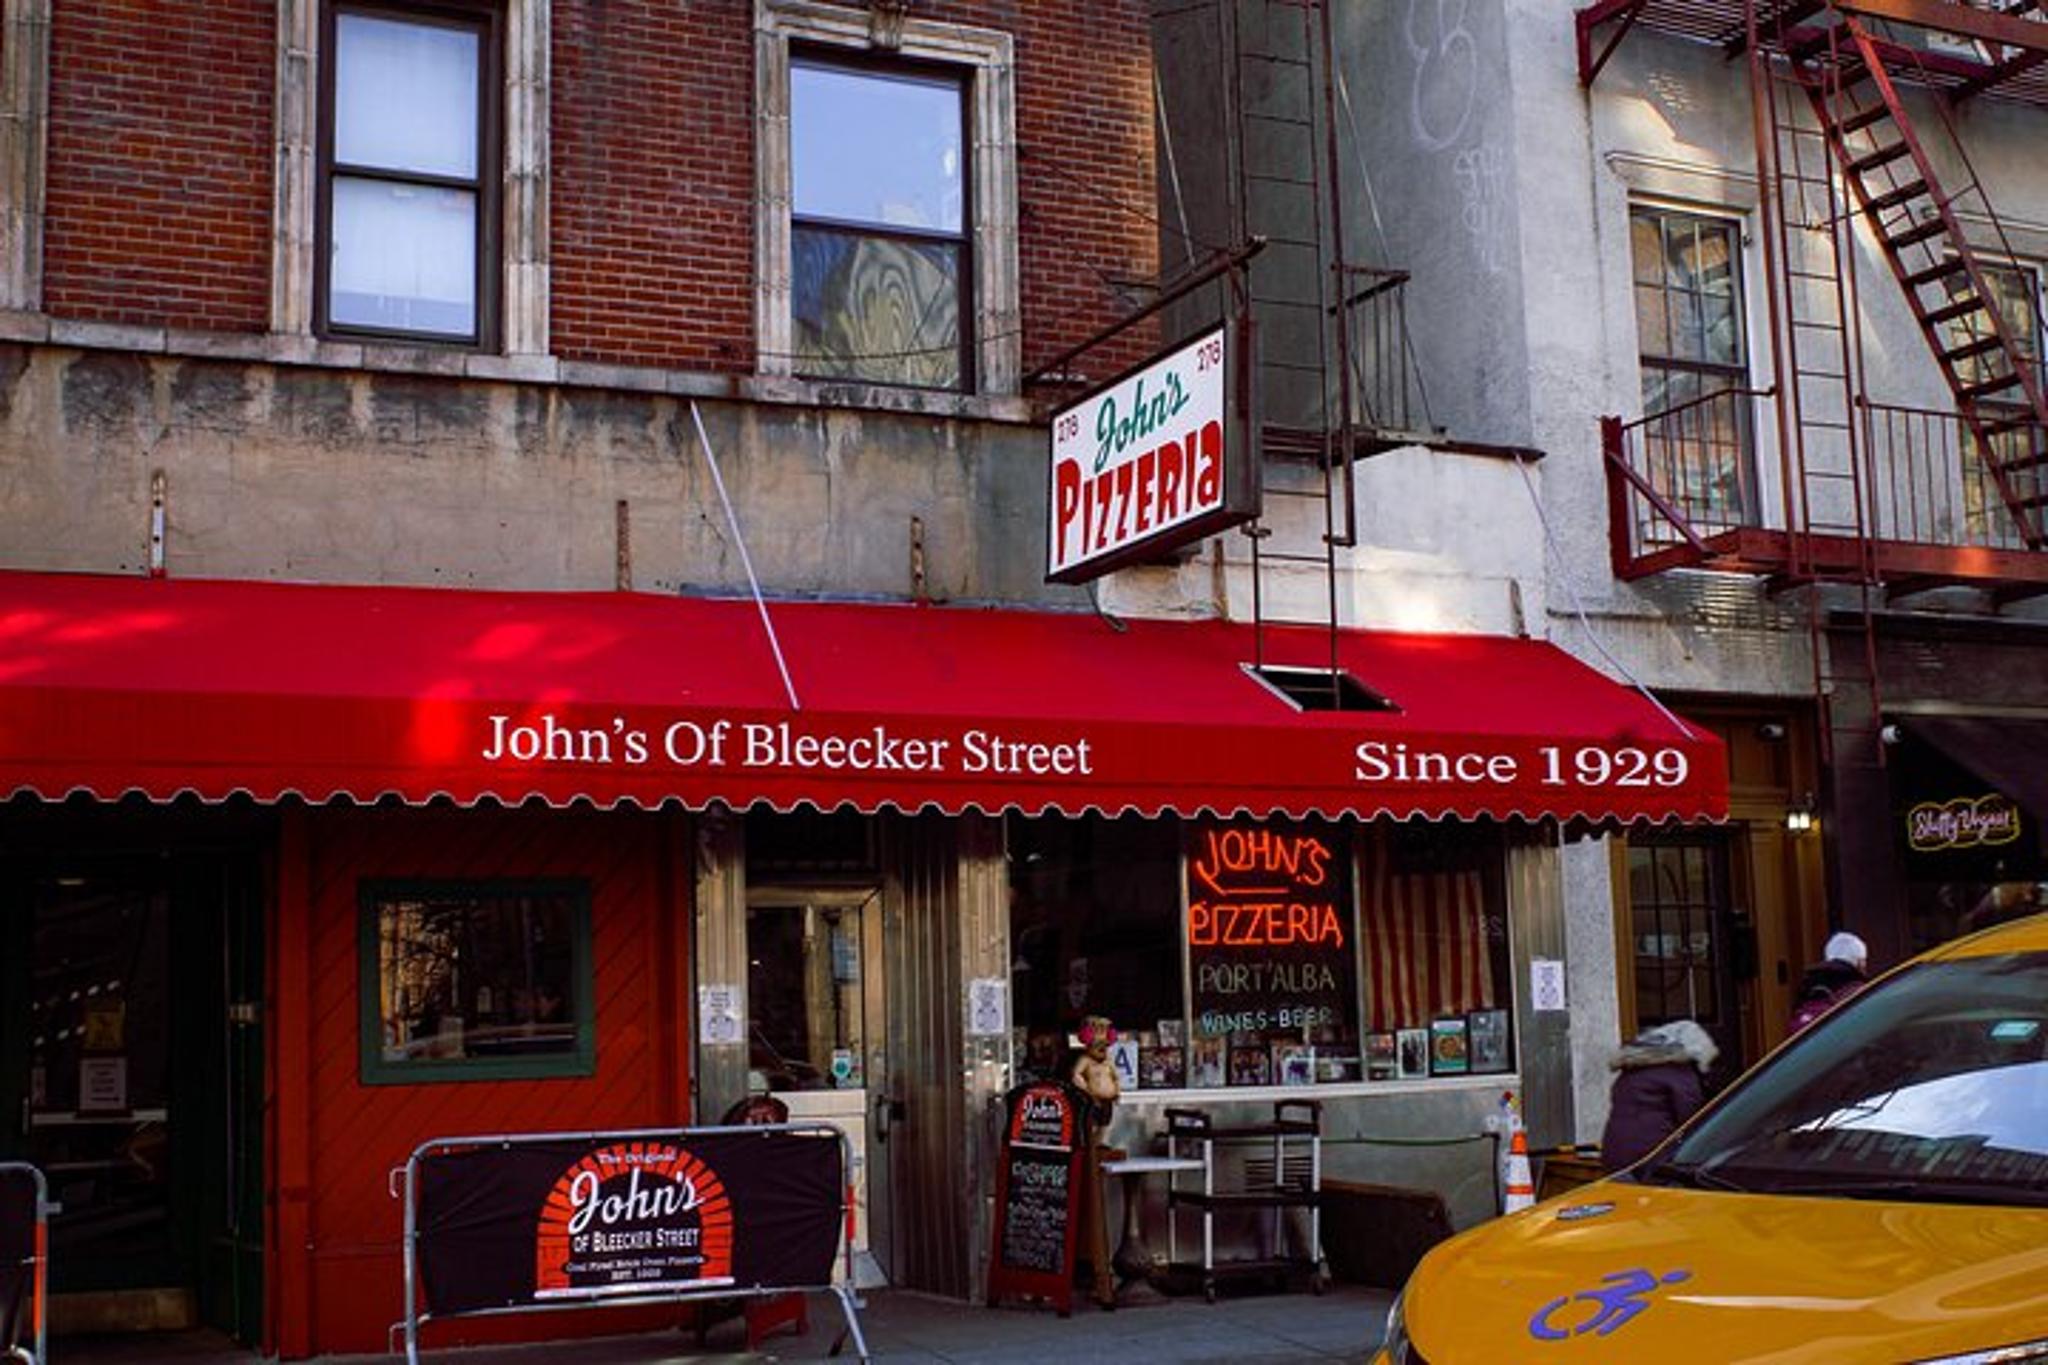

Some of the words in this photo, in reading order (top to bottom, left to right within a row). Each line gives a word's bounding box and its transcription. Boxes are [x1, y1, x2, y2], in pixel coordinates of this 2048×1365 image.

[1094, 371, 1190, 473] John's
[483, 716, 649, 765] John's
[665, 721, 728, 764] Of
[742, 723, 949, 773] Bleecker
[963, 731, 1093, 775] Street
[1355, 742, 1517, 783] Since
[1539, 747, 1689, 787] 1929
[1196, 829, 1332, 890] JOHN'S
[1190, 902, 1344, 949] PIZZERIA
[1114, 1046, 1133, 1076] A
[568, 1166, 706, 1235] John's
[656, 1228, 700, 1248] STREET
